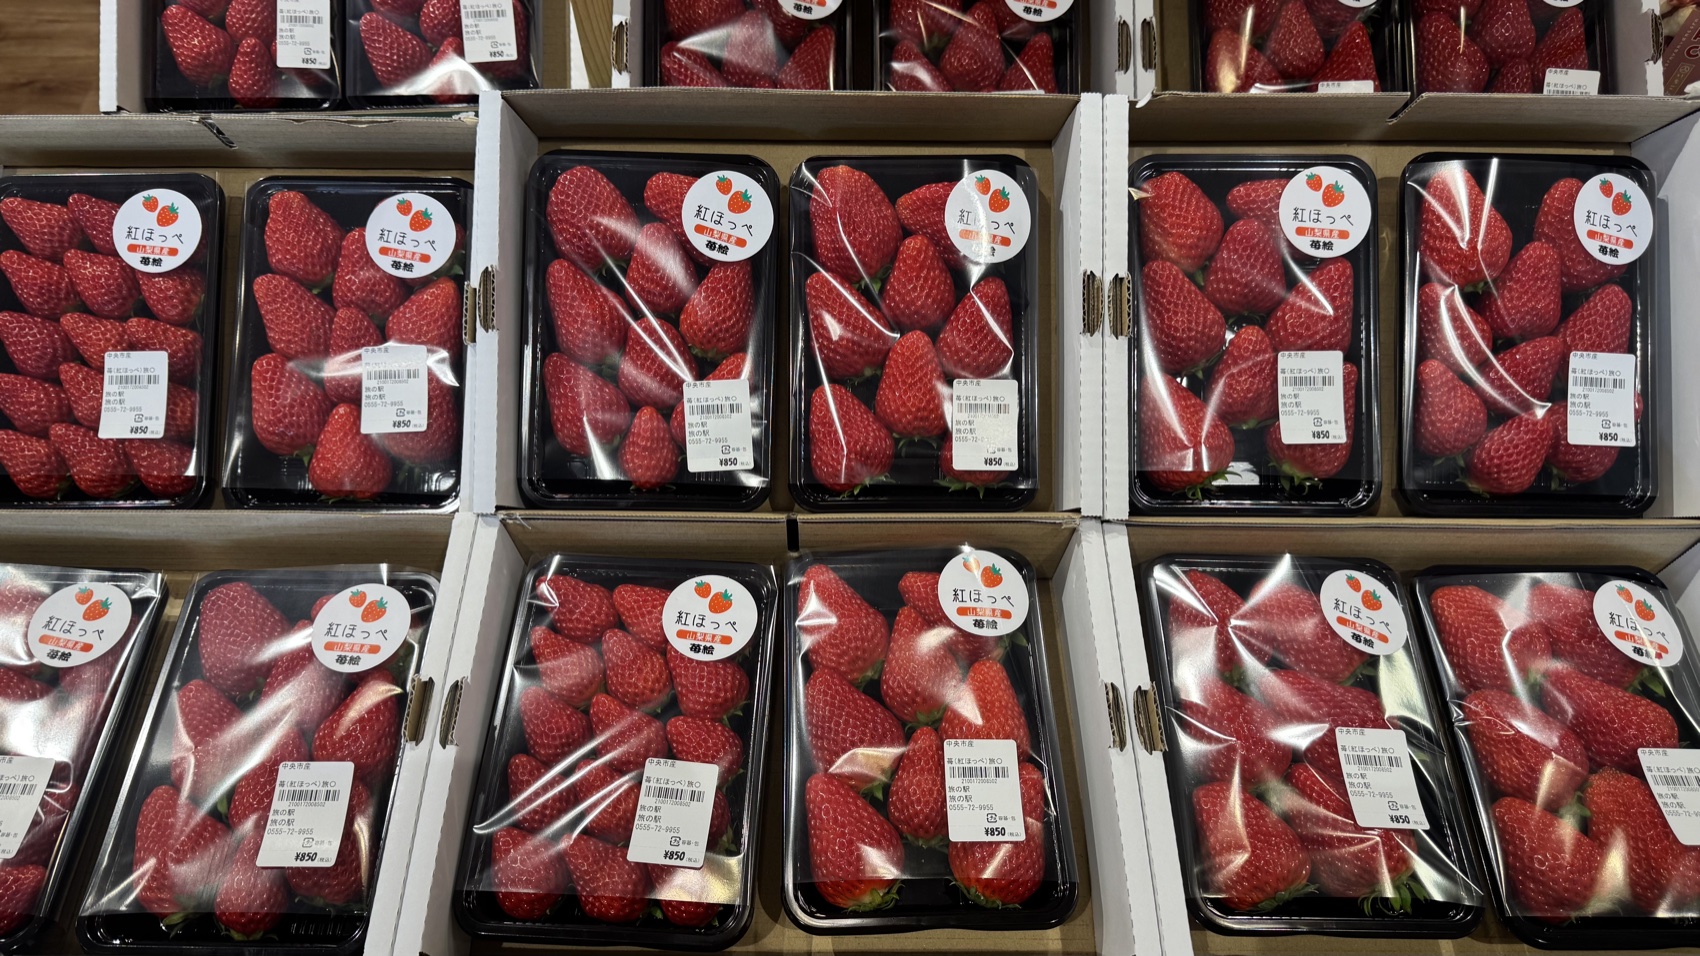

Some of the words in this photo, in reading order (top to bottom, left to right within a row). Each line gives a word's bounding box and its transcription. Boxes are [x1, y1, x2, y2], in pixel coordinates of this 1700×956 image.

[694, 204, 753, 236] 紅ほっぺ
[957, 209, 1015, 234] 紅っぺ
[1292, 207, 1353, 226] 紅ほっぺ
[1585, 210, 1637, 237] 紅ほっぺ
[125, 226, 183, 244] 紅ほっぺ
[704, 228, 737, 245] 山梨県産
[1305, 228, 1339, 239] 山梨県産
[378, 228, 436, 251] 紅ほっぺ
[1595, 234, 1624, 248] 山梨県産
[136, 246, 169, 255] 山梨県産
[706, 240, 729, 255] 苺絵
[1310, 240, 1334, 251] 苺絵
[388, 249, 421, 262] 山梨県産
[1598, 245, 1619, 258] 苺絵
[140, 257, 162, 267] 苺絵
[391, 260, 414, 272] 苺絵
[392, 420, 411, 428] ¥850
[130, 426, 148, 434] ¥850
[1312, 430, 1330, 439] ¥850
[1599, 432, 1618, 441] ¥850
[720, 457, 738, 466] ¥850
[984, 457, 1002, 466] ¥850
[952, 588, 1014, 607] 紅ほっぺ
[968, 607, 1002, 617] 山梨県産
[1333, 598, 1392, 634] 紅ほっぺ
[675, 610, 738, 632] 紅ほっぺ
[973, 619, 998, 629] 苺絵
[42, 615, 104, 640] 紅ほっぺ
[324, 622, 387, 640] 紅ほっぺ
[1346, 621, 1379, 640] 山梨県産
[687, 632, 722, 643] 山梨県産
[1351, 632, 1374, 649] 苺絵
[48, 638, 84, 651] 山梨県産
[334, 643, 370, 653] 山梨県産
[690, 643, 714, 655] 苺絵
[47, 649, 72, 661] 苺絵
[335, 655, 361, 665] 苺絵
[648, 760, 676, 768] 中央市産
[639, 804, 661, 812] 旅の駅
[637, 814, 661, 823] 旅の駅
[1389, 814, 1410, 824] ¥850
[636, 824, 680, 833] 0555-72-9955
[984, 827, 1006, 836] ¥850
[294, 852, 317, 862] ¥850
[663, 850, 685, 860] ¥850
